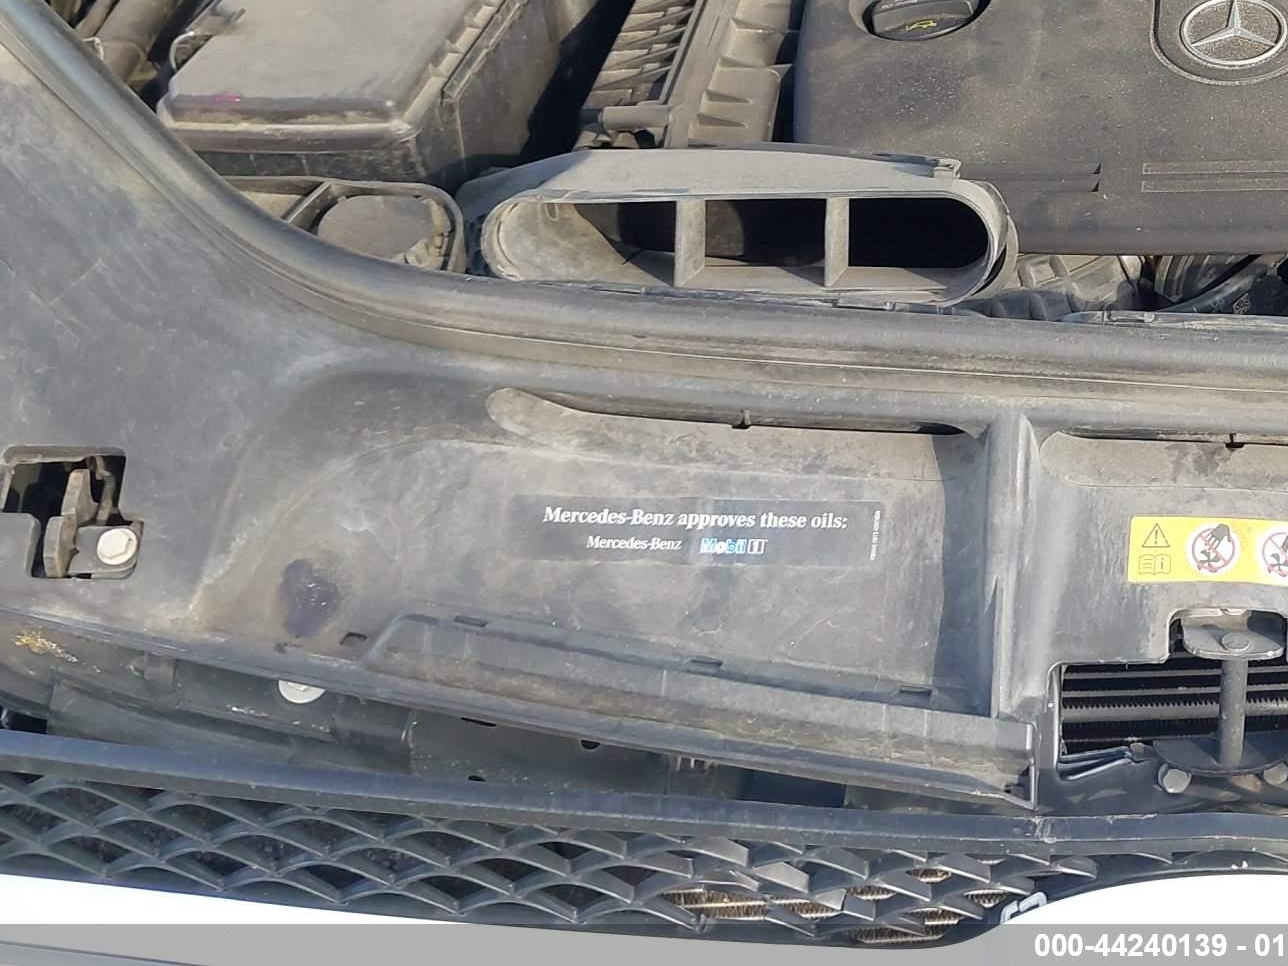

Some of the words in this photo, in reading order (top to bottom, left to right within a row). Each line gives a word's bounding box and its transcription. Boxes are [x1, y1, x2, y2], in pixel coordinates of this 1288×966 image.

[543, 507, 675, 525] Mercedes-Benz
[677, 512, 755, 530] approves
[760, 512, 807, 528] these
[811, 513, 848, 529] oils:
[586, 536, 682, 550] Mercedes-Benz
[700, 538, 747, 554] Mobil
